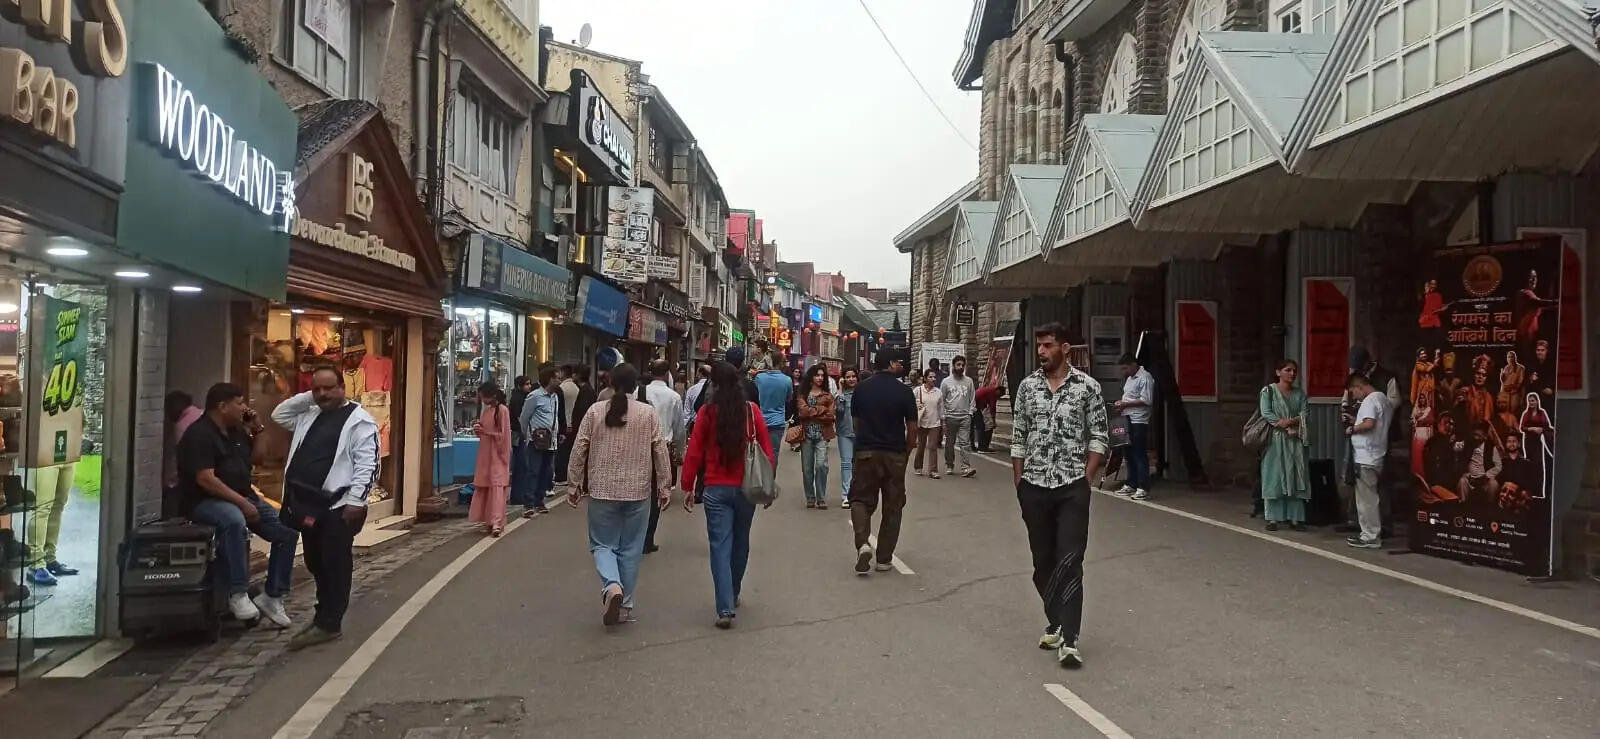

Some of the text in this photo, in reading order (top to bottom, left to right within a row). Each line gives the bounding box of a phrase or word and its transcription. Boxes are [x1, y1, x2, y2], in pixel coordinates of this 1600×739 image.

[5, 48, 78, 148] BAR
[157, 63, 276, 216] WOODLAND
[503, 262, 533, 293] MINERVA
[533, 273, 550, 297] BOOK
[550, 279, 567, 302] HOUSE
[1493, 311, 1513, 323] का
[59, 324, 77, 341] SLAM
[1493, 326, 1518, 342] दिन
